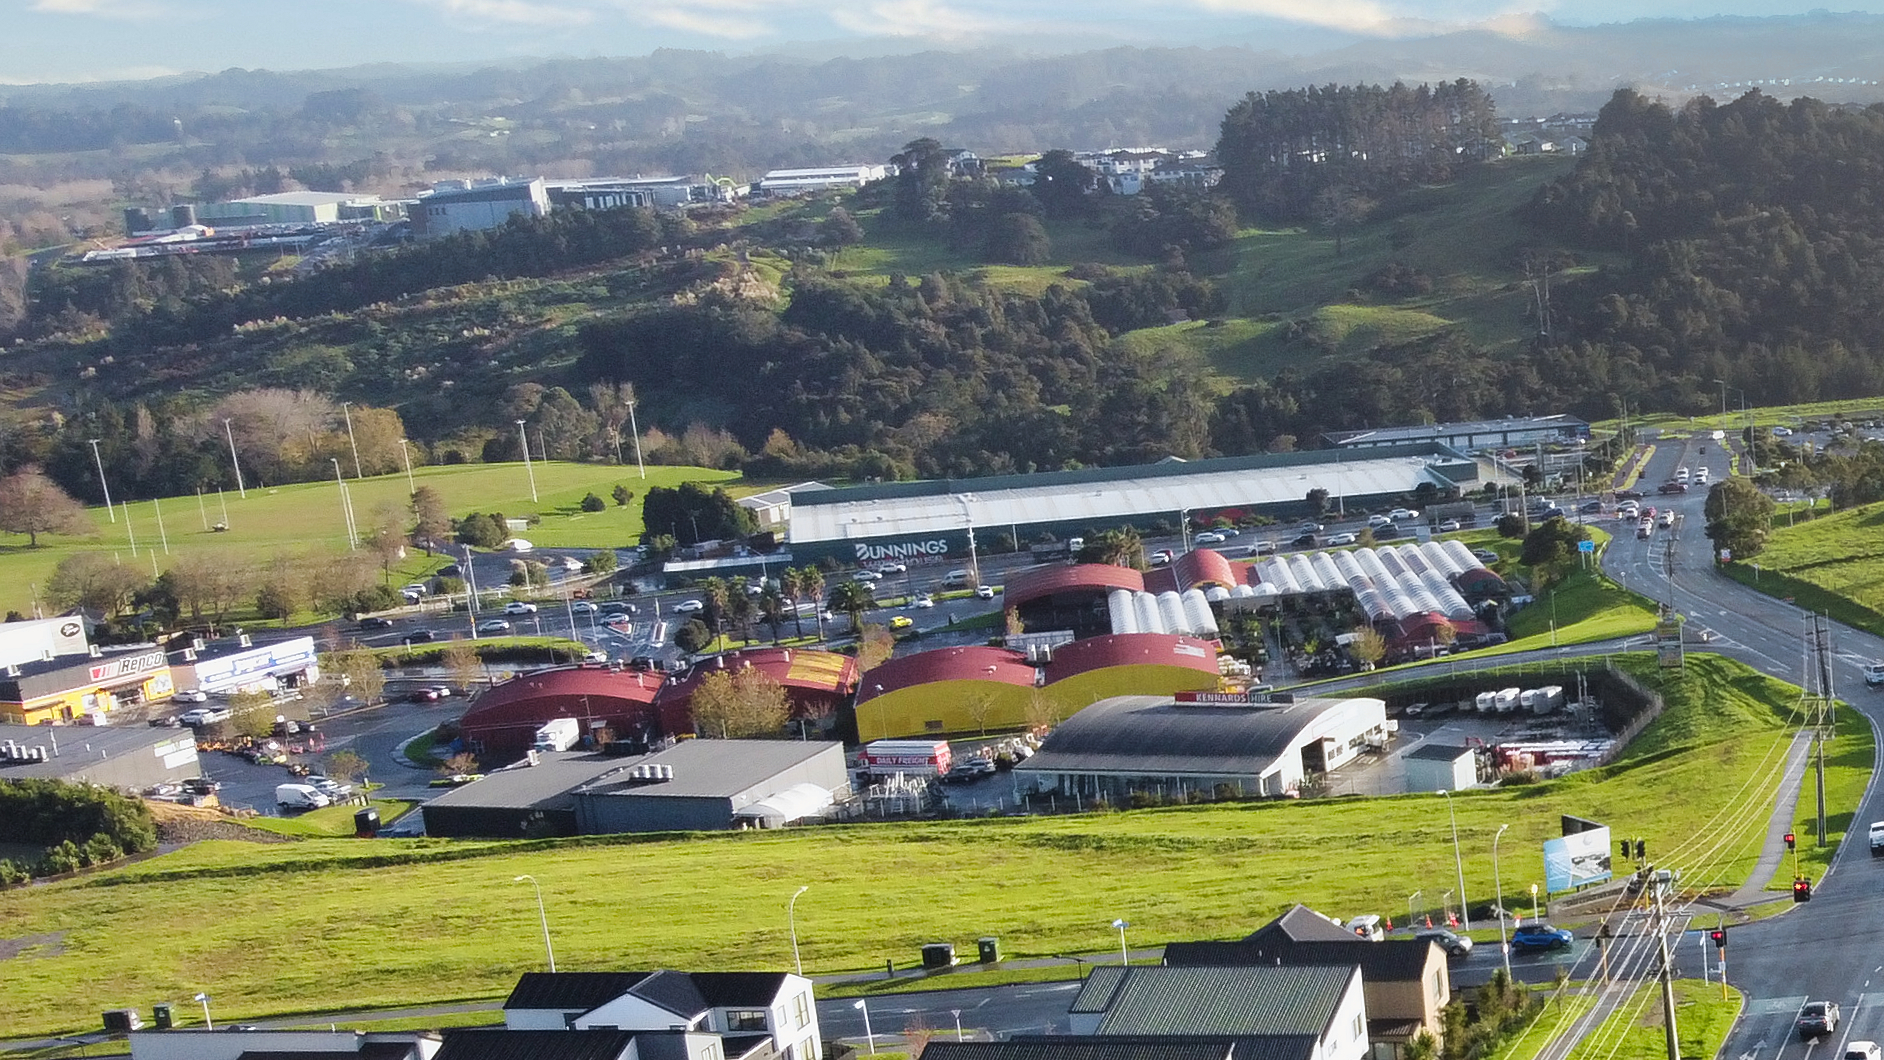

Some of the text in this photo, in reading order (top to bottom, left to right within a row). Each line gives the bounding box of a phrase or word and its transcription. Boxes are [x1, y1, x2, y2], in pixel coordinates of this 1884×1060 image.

[855, 540, 948, 560] BUNNINGS
[1196, 693, 1272, 703] KENNARDS HIRE
